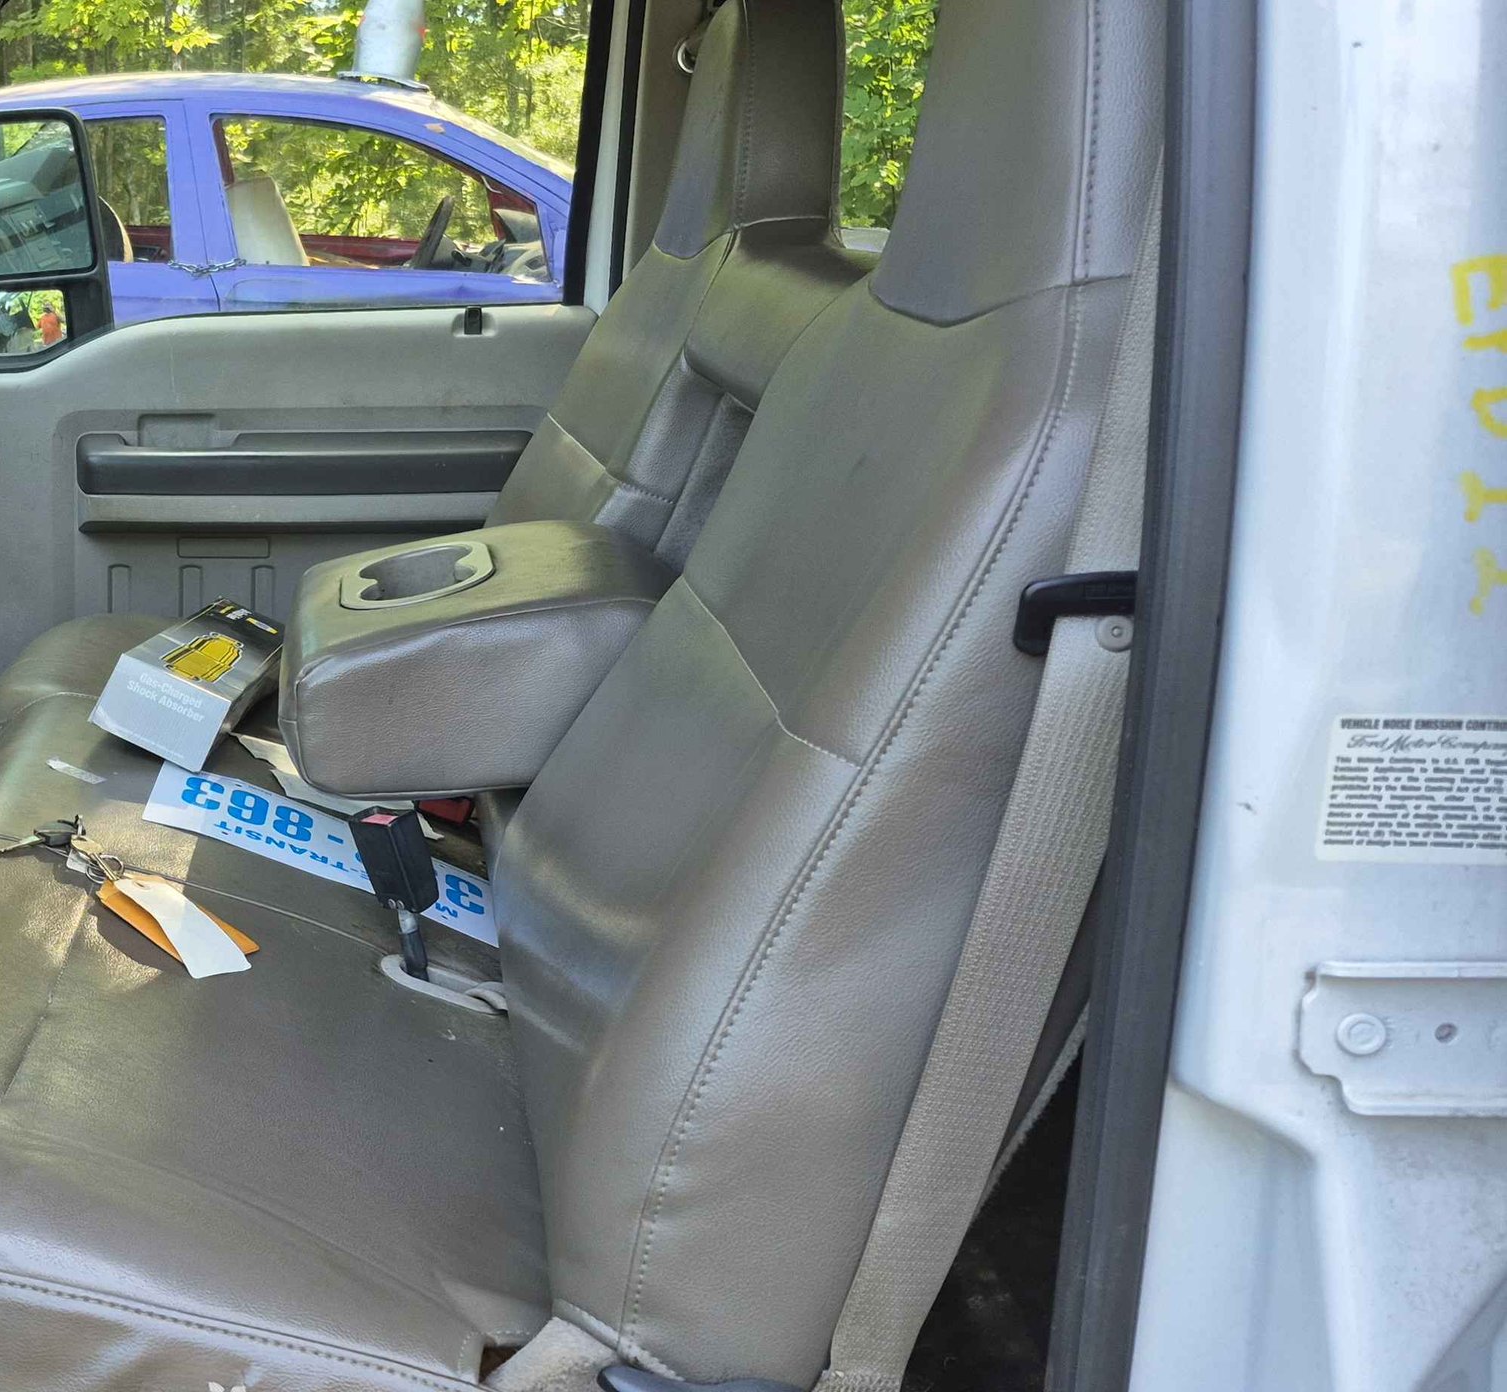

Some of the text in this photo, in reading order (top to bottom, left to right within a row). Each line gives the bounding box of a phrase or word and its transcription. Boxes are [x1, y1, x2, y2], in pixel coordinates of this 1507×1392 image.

[126, 680, 205, 723] Shock Absorber
[139, 672, 203, 709] Gas-Charged
[1341, 718, 1380, 730] VEHICLE
[1382, 719, 1412, 730] NOISE
[1414, 719, 1464, 731] EMISSION
[181, 777, 314, 842] 863
